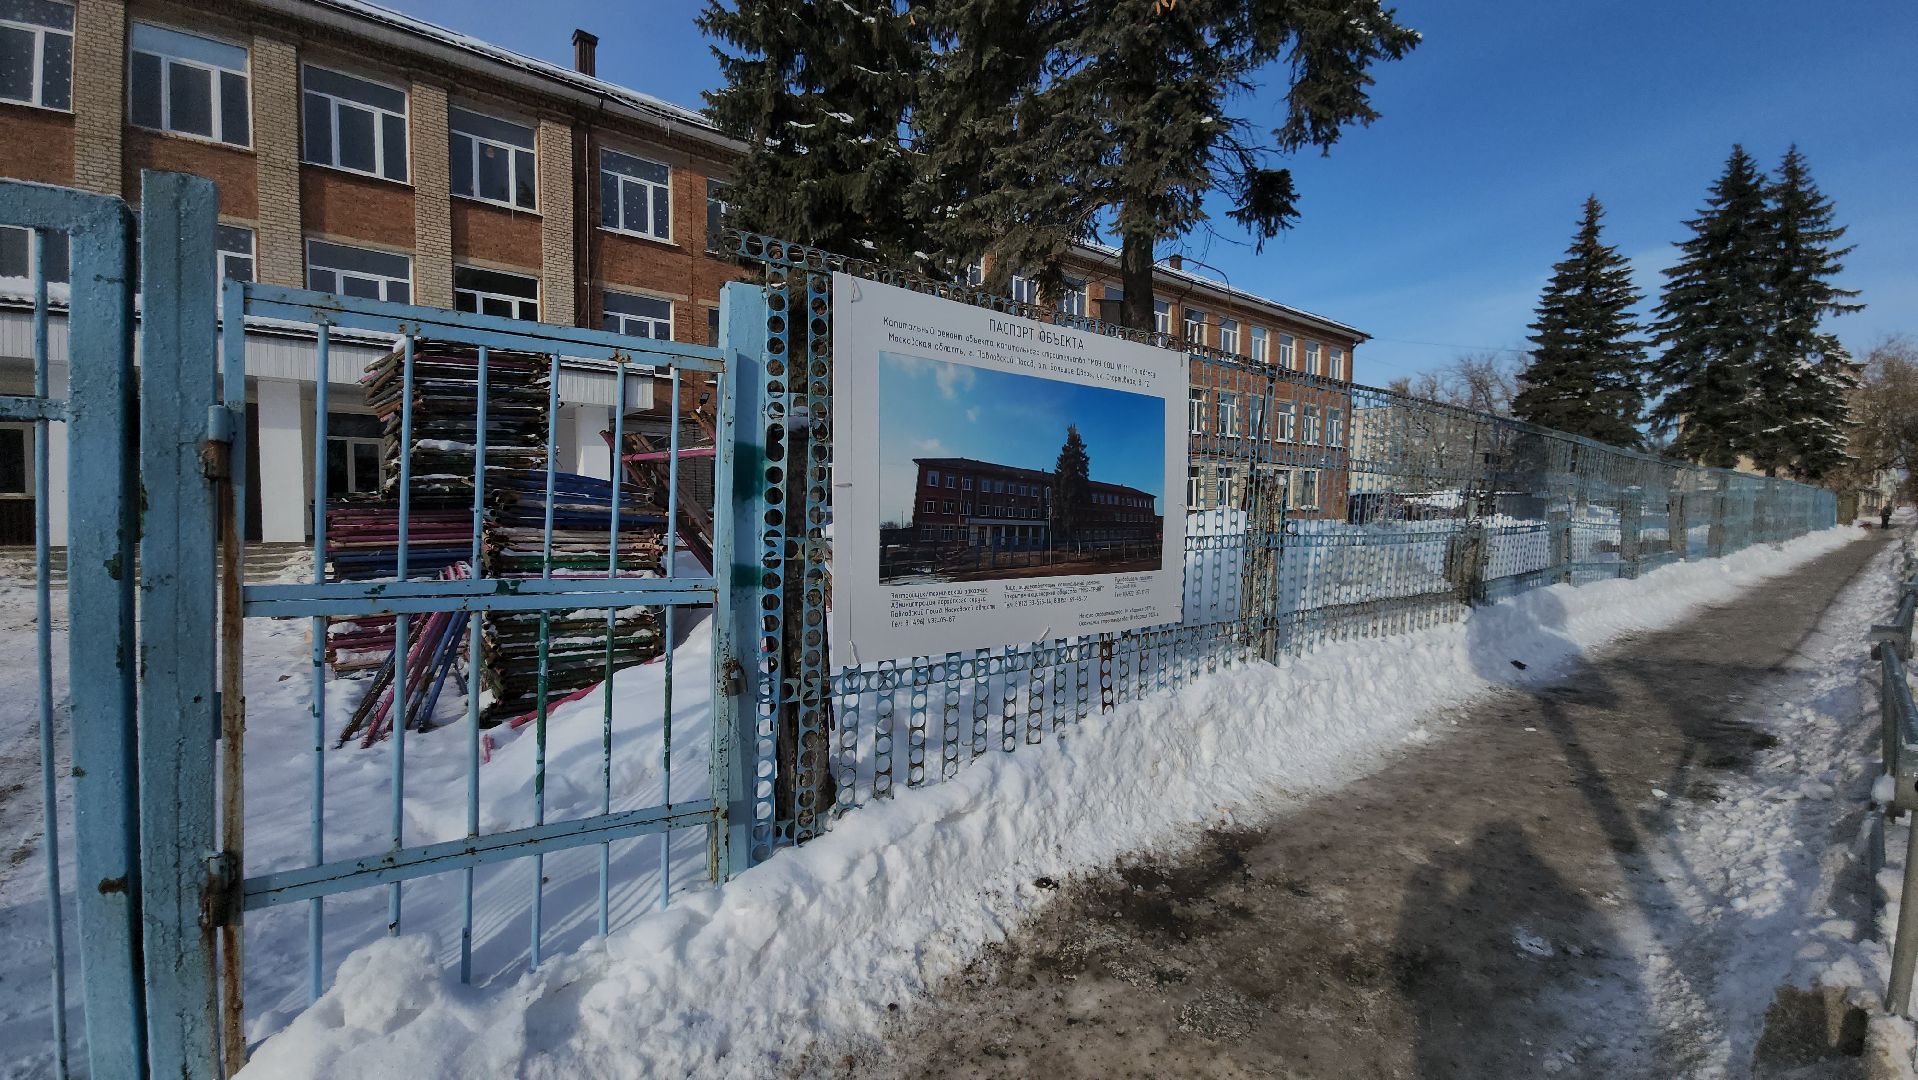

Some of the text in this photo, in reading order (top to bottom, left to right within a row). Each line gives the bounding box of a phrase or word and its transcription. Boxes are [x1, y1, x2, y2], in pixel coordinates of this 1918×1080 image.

[883, 316, 934, 335] Капитальный
[938, 329, 962, 341] ремонт
[966, 334, 994, 347] объекта
[888, 332, 932, 349] Московская
[934, 342, 966, 356] область,
[989, 318, 1084, 350] ПАСПОРТ ОБЪЕКТА
